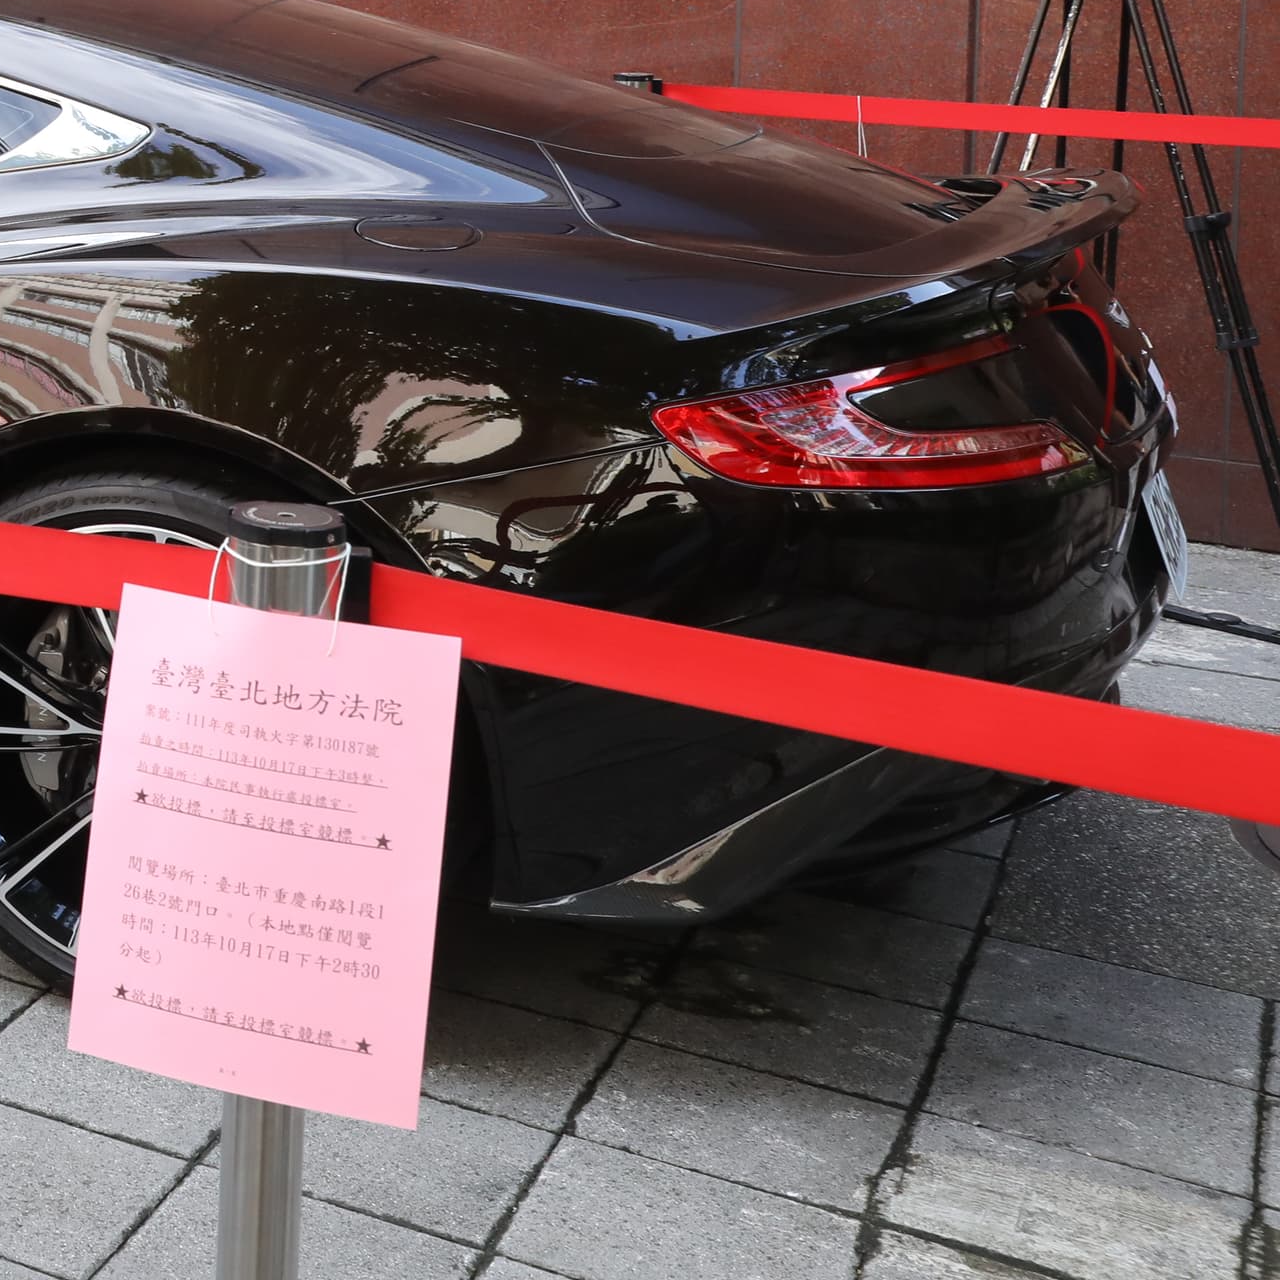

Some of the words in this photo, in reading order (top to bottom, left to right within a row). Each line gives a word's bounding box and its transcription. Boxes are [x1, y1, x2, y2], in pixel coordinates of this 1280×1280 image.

[151, 657, 404, 727] 臺灣臺北地方法院
